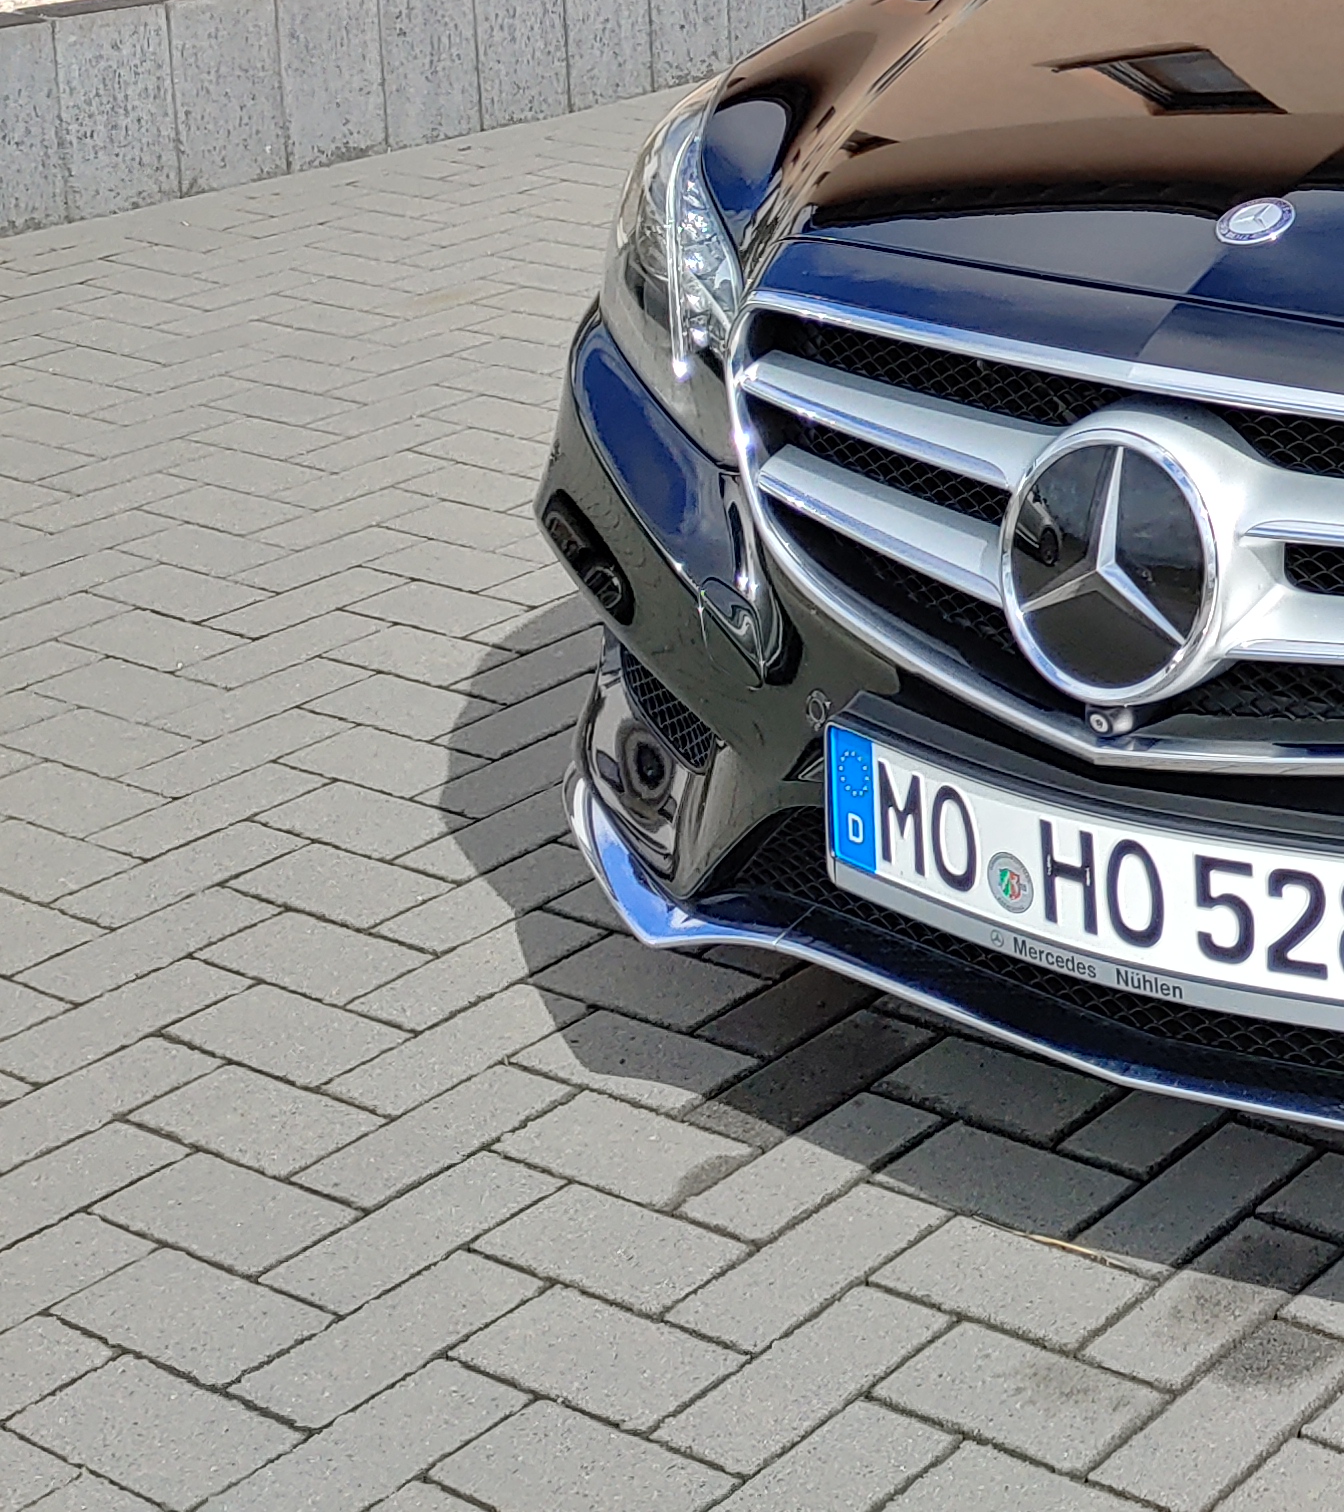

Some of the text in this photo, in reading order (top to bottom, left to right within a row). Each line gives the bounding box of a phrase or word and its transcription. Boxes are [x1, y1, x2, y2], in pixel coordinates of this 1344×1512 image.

[847, 812, 864, 844] D
[878, 758, 978, 892] MO
[1038, 817, 1164, 949] HO
[1013, 936, 1184, 999] Mercedes Nühlen
